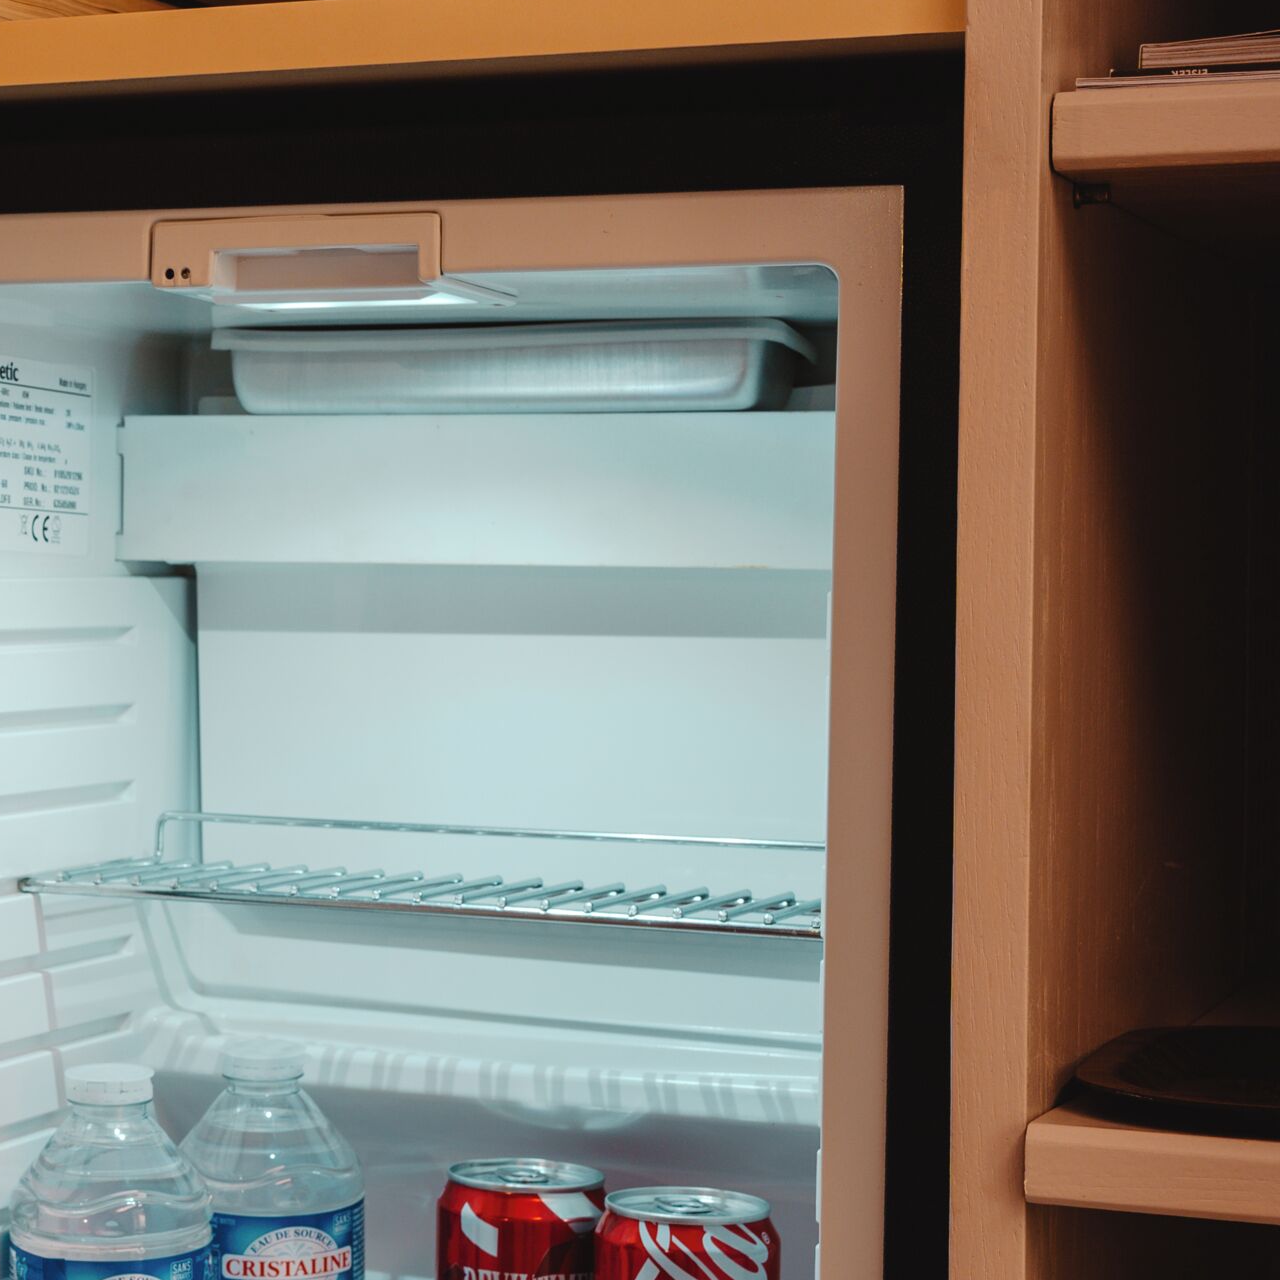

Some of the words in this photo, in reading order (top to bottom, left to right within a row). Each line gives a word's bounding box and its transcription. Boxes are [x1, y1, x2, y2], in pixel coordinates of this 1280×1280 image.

[251, 1234, 273, 1254] EAU
[275, 1230, 290, 1241] DE
[294, 1229, 334, 1250] SOURCE
[225, 1249, 351, 1278] CRISTALINE
